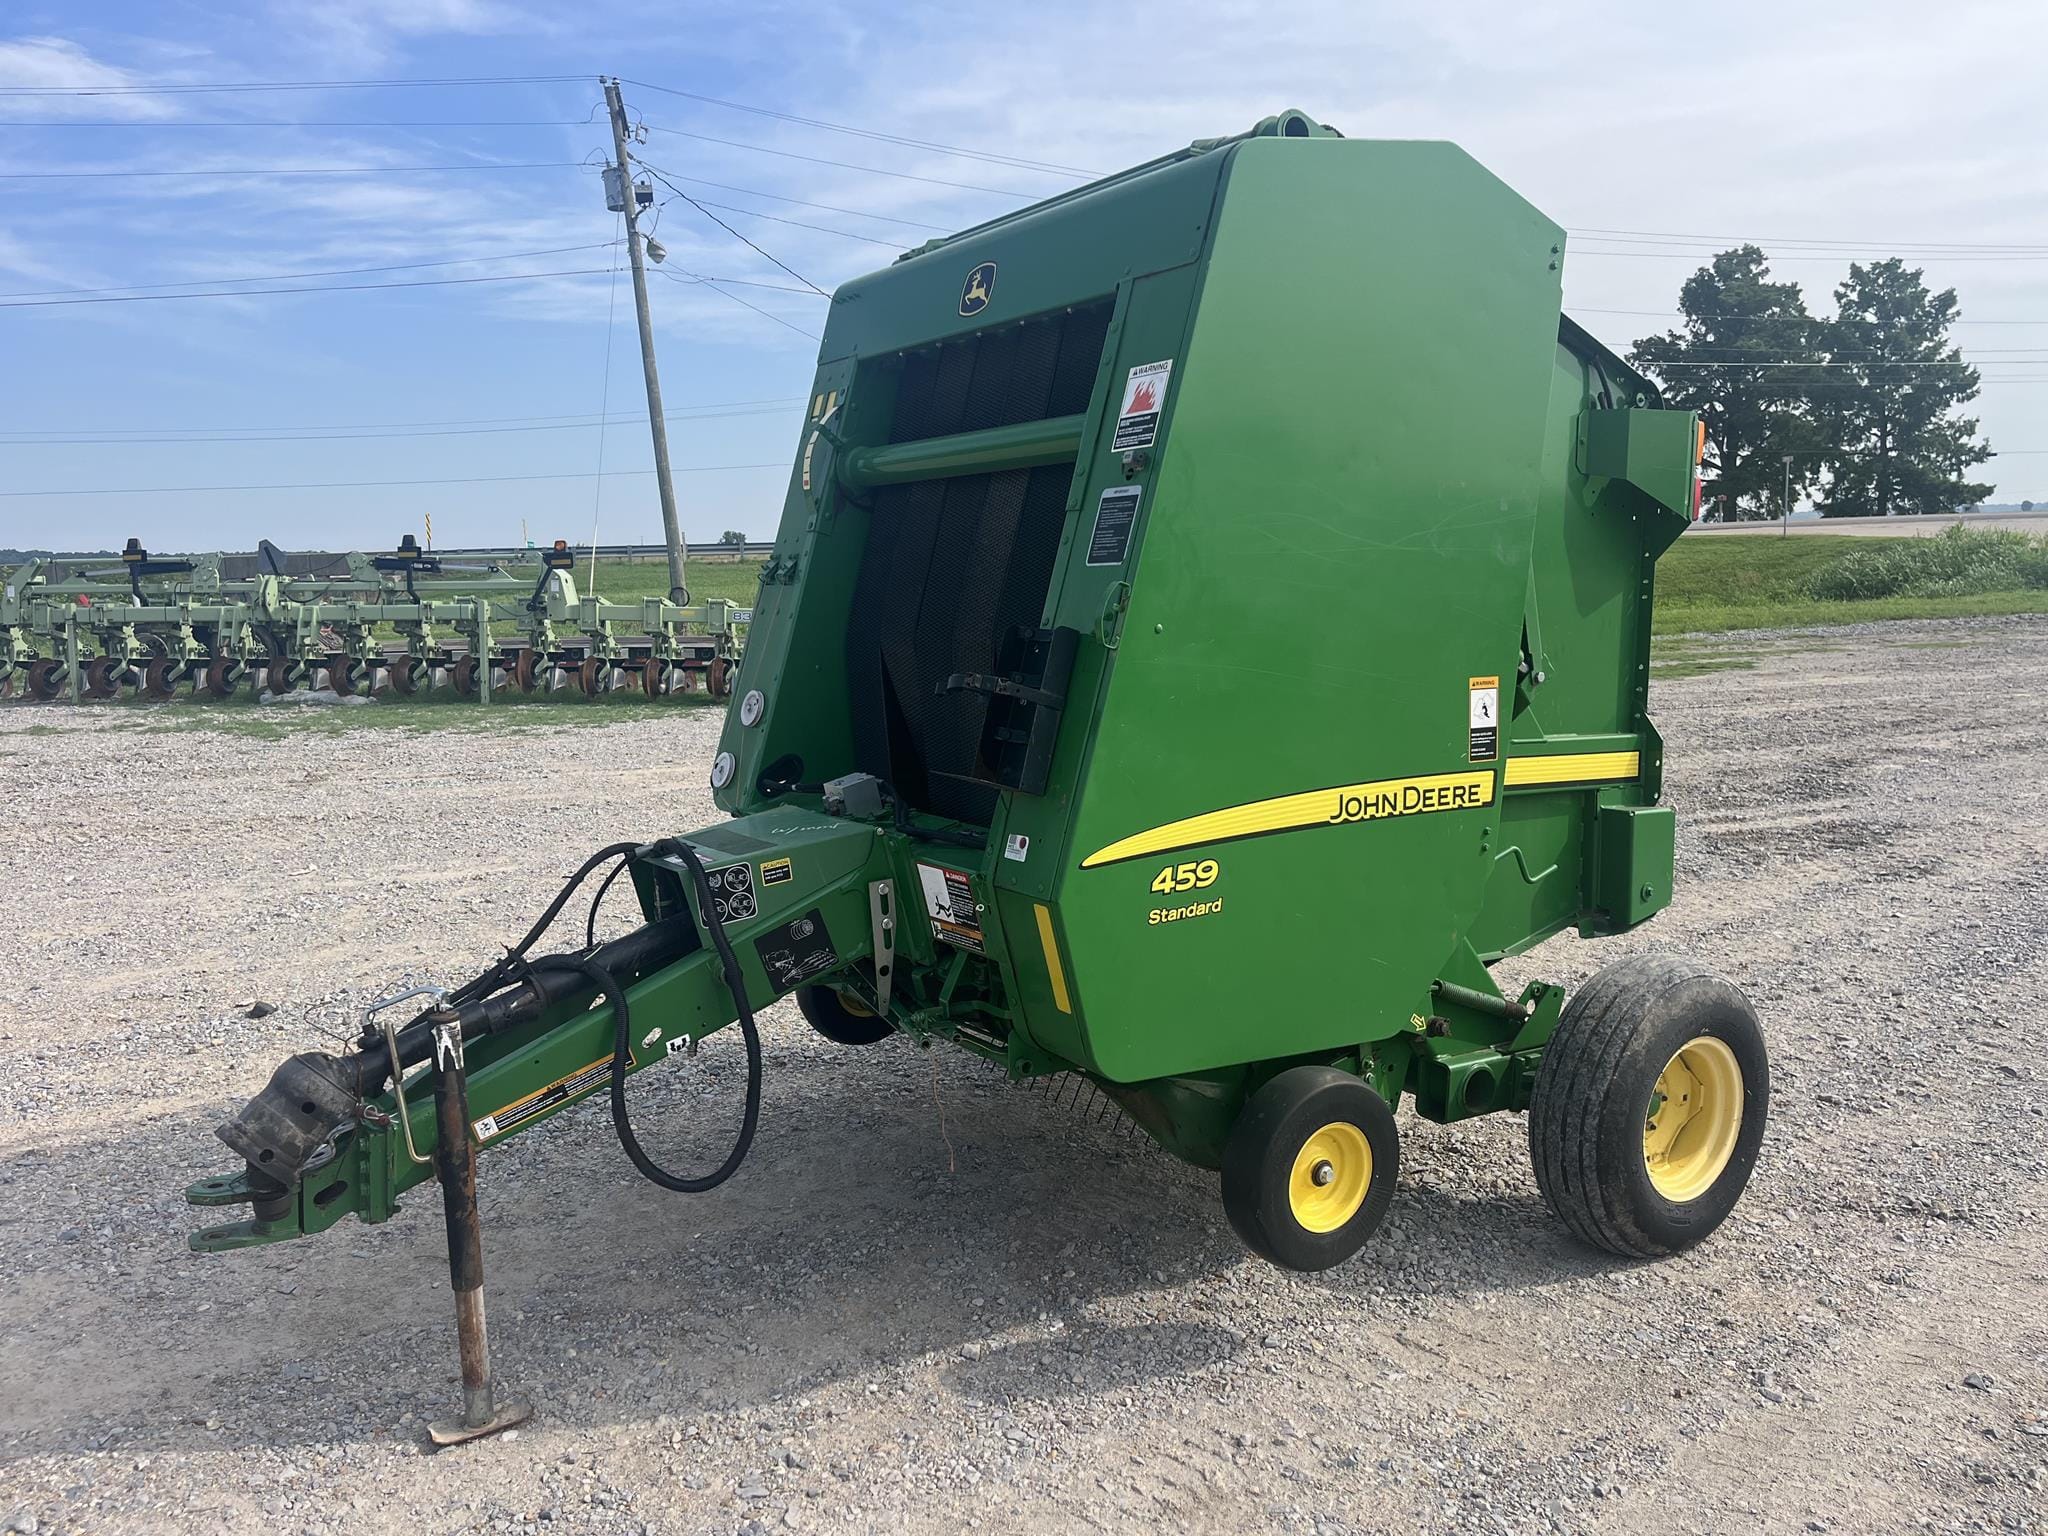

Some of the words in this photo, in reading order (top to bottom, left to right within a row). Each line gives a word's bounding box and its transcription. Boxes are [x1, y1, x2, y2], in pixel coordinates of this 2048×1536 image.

[1138, 362, 1168, 374] WARNING
[1330, 792, 1397, 820] JOHN
[1403, 784, 1481, 811] DEERE
[767, 860, 789, 869] CAUTION
[1150, 859, 1219, 895] 459
[1148, 897, 1223, 925] Standard
[551, 1073, 577, 1089] WARNING
